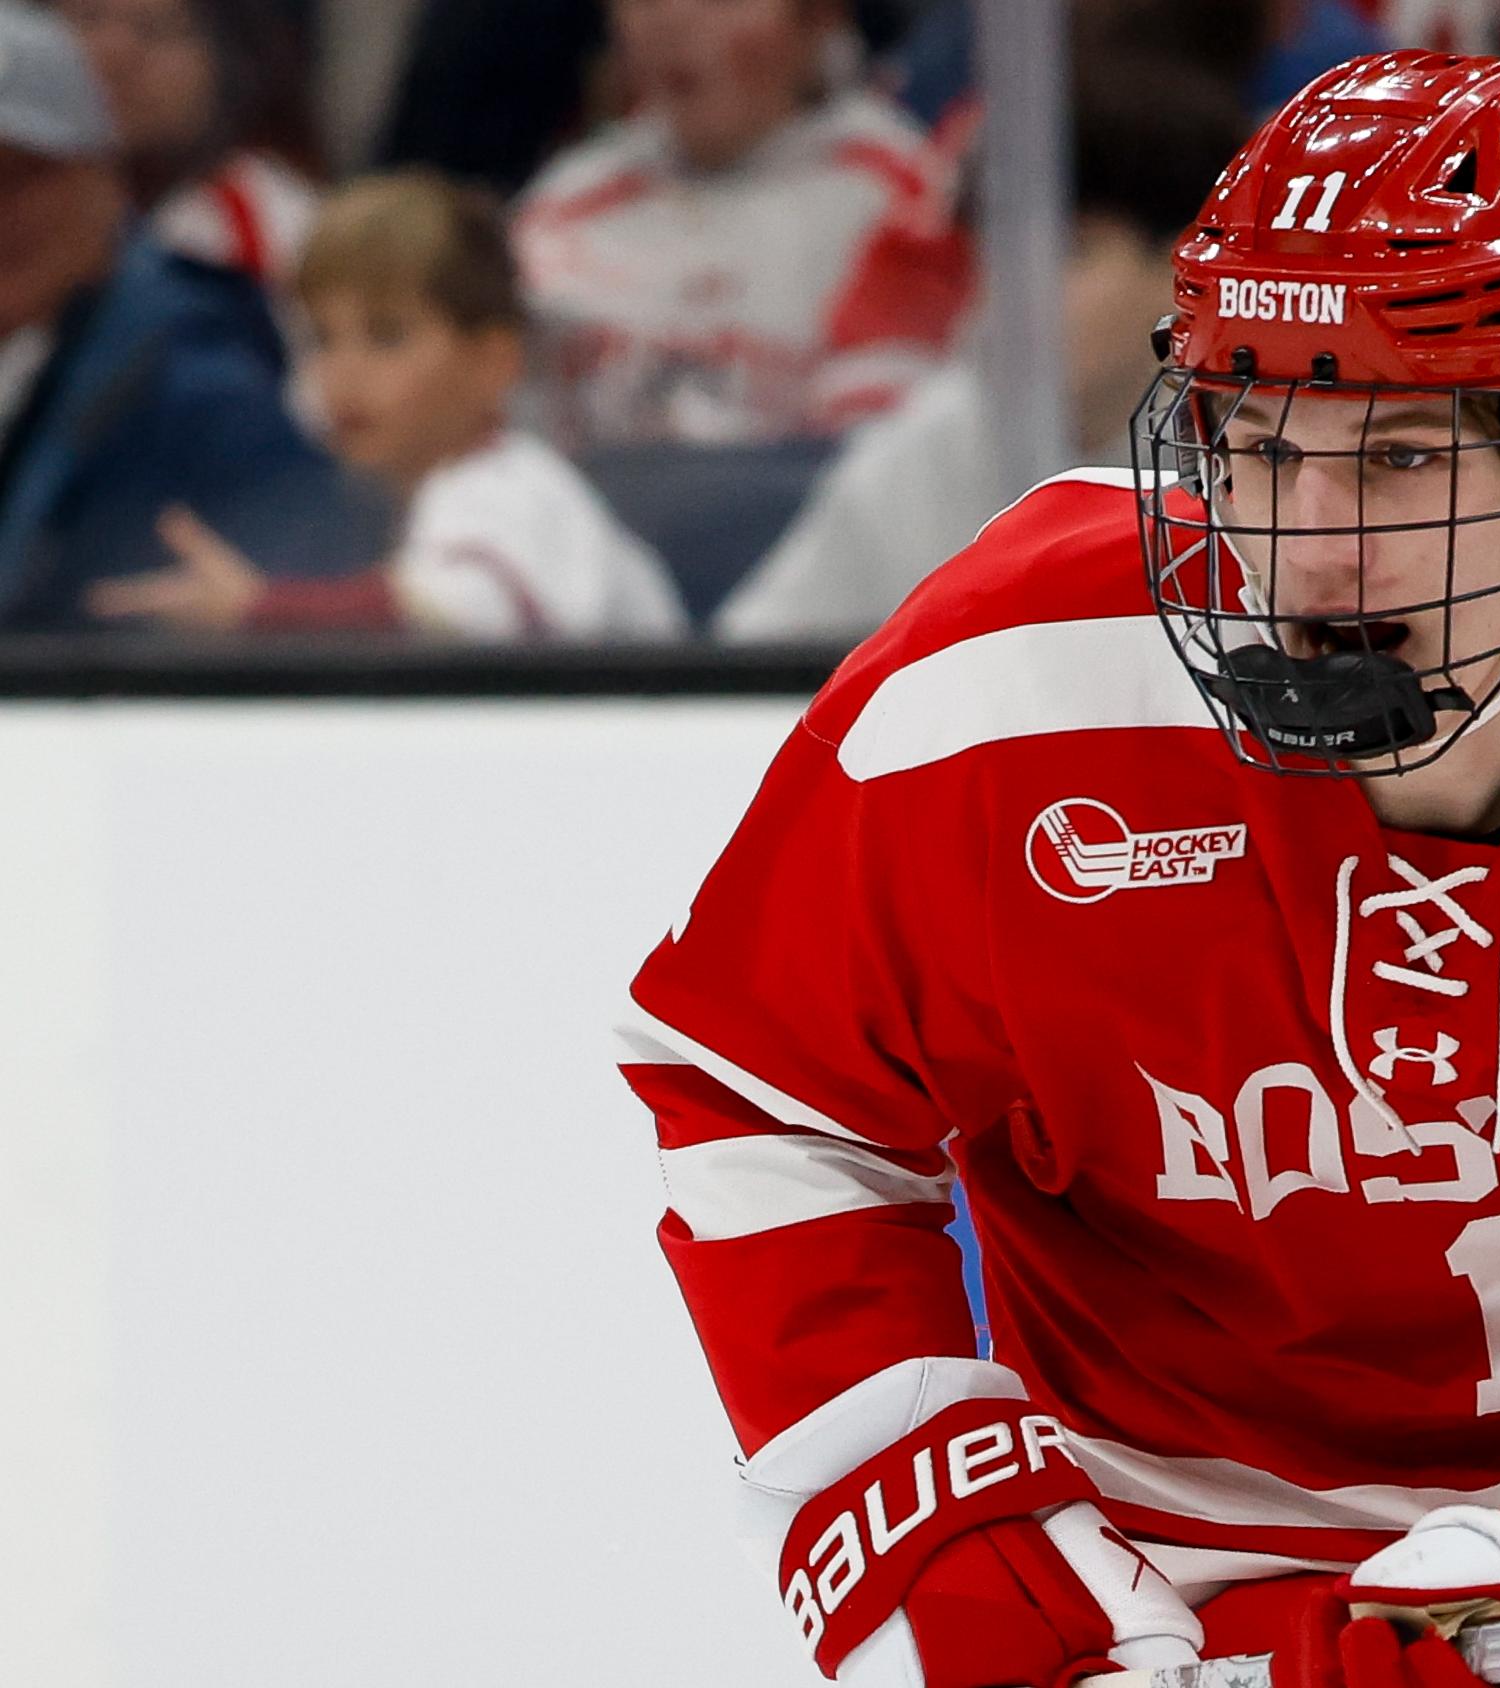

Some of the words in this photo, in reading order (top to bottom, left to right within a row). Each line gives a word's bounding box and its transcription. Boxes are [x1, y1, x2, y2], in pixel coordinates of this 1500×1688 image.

[1271, 171, 1347, 232] 11
[1218, 277, 1346, 324] BOSTON
[1132, 830, 1241, 859] HOCKEY
